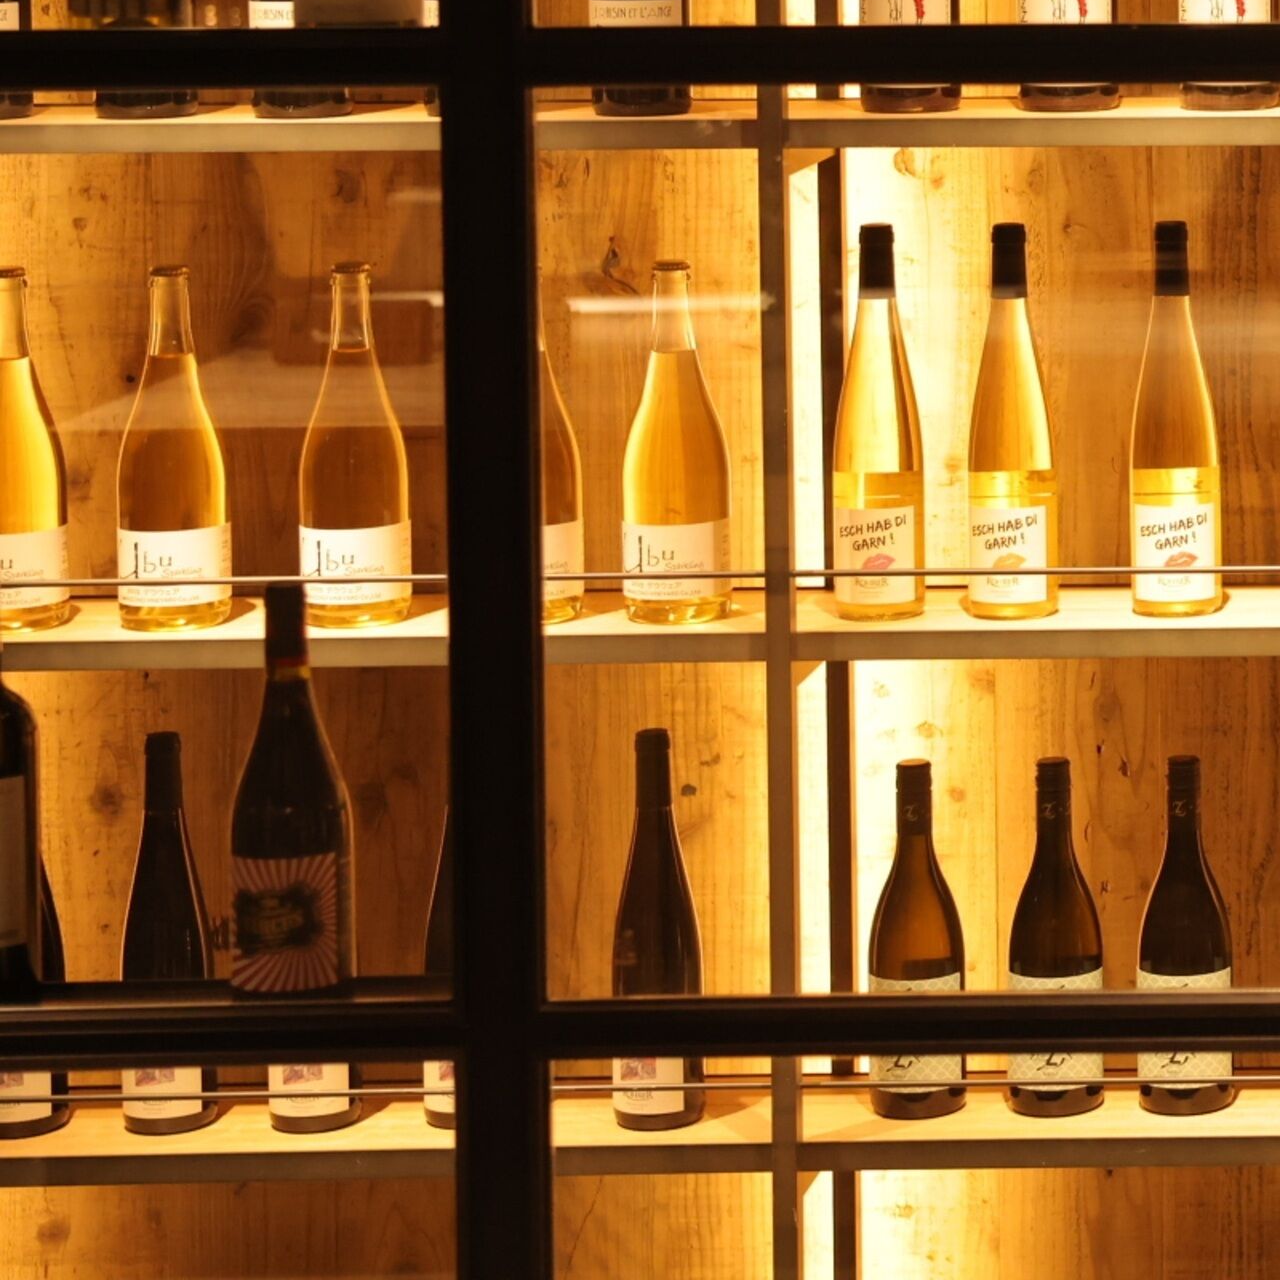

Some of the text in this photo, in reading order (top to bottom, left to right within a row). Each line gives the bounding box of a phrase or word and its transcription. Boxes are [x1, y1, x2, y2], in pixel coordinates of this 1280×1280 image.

[839, 514, 907, 538] ESCH HAB DI
[972, 514, 1038, 537] ESCH HAB DI
[1140, 513, 1208, 537] ESCH HAB DI
